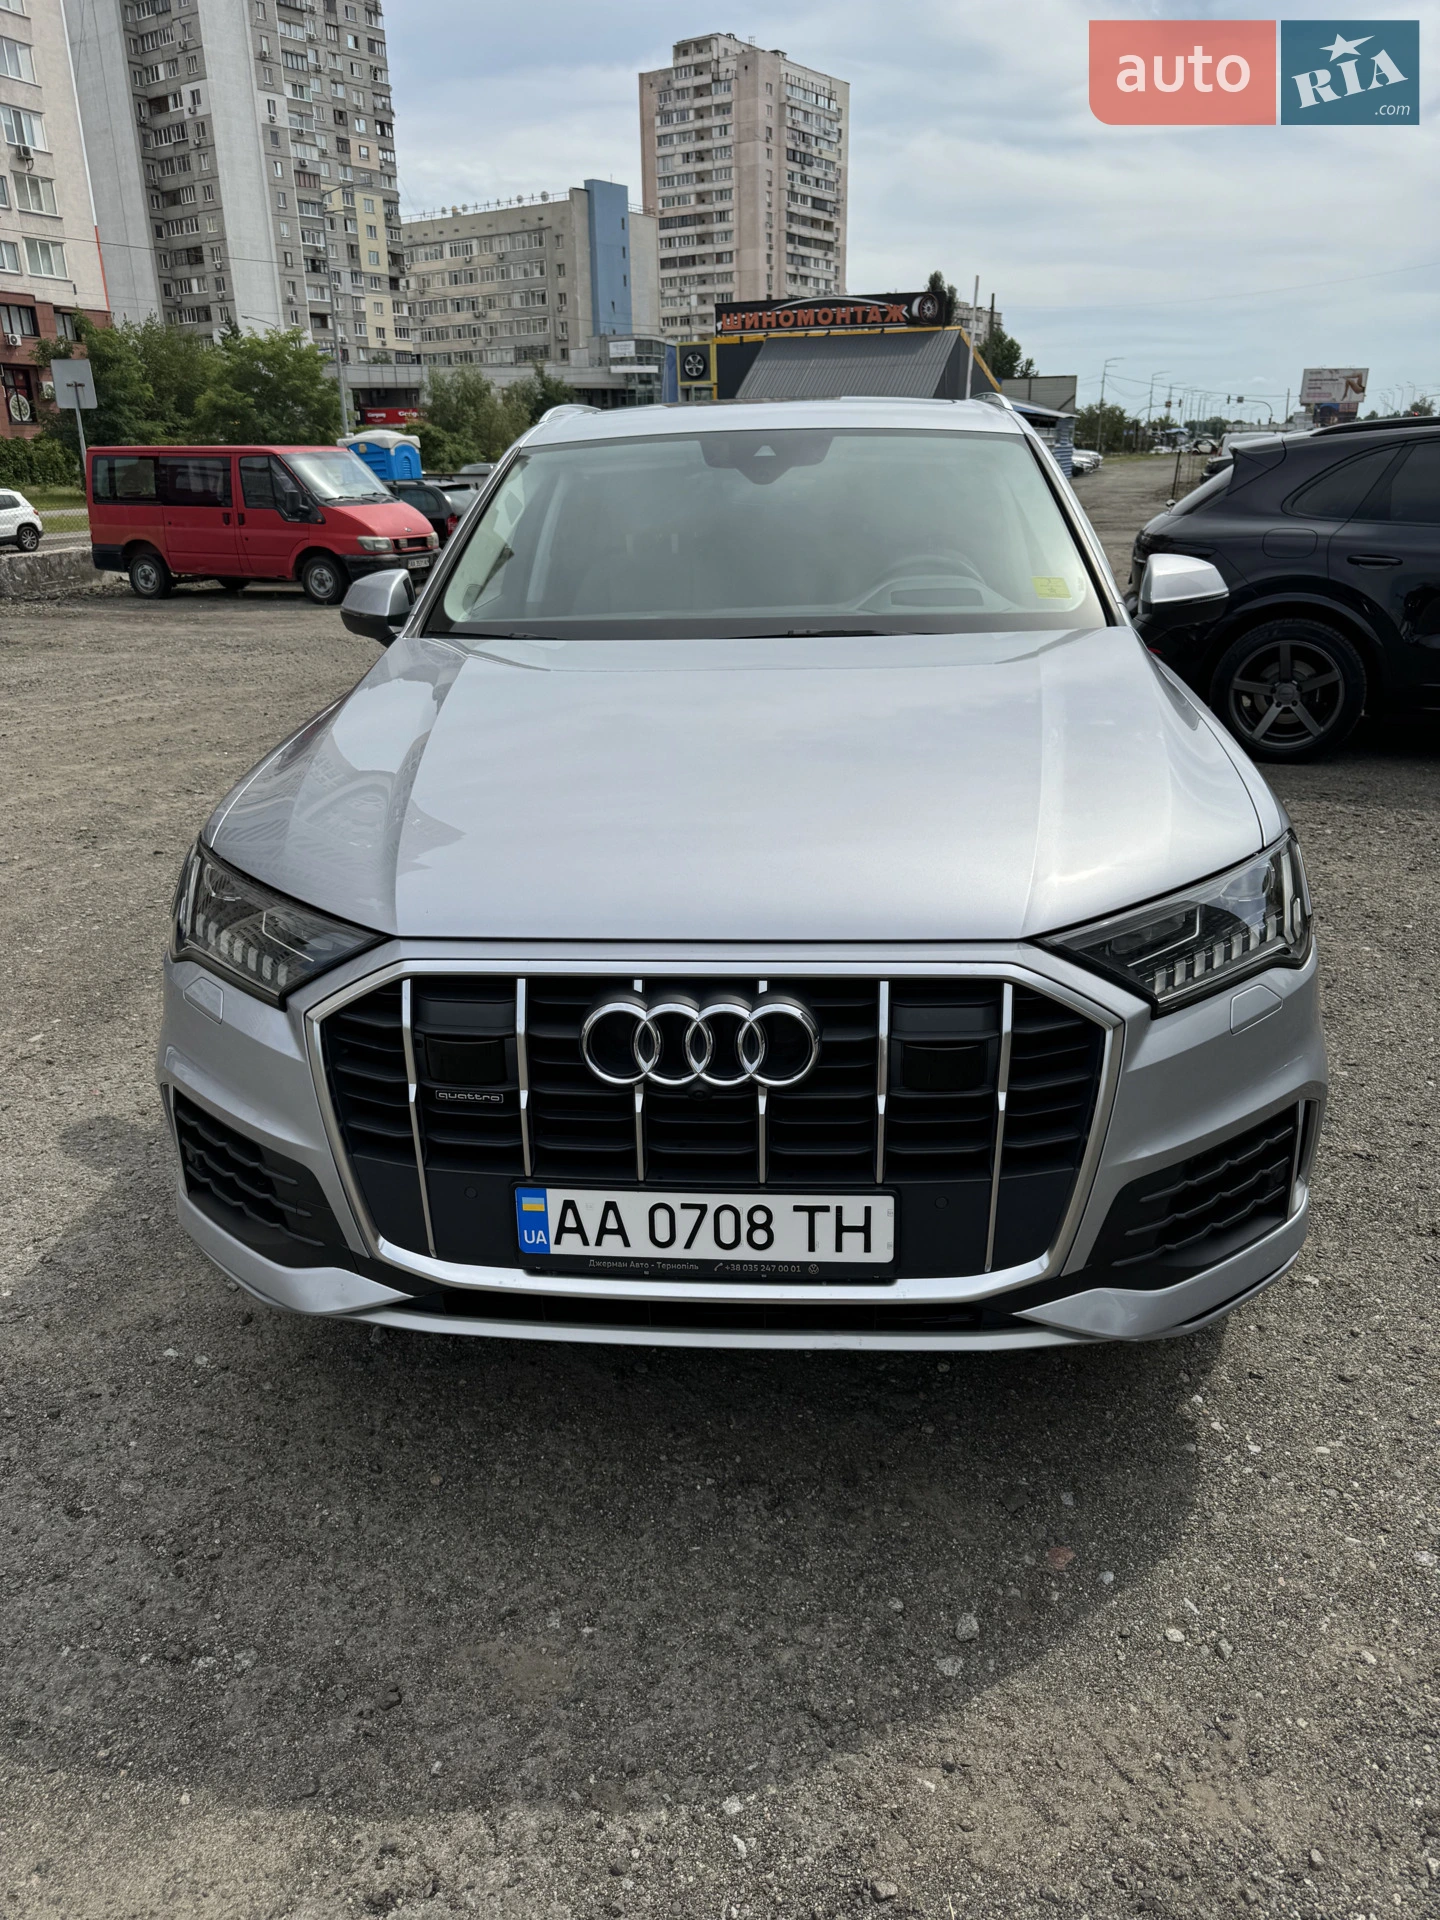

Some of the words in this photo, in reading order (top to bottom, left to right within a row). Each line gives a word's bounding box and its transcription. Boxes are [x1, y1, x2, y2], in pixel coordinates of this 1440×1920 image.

[721, 304, 906, 331] ШИНОМОНТАЖ
[438, 1092, 500, 1101] quattro
[554, 1199, 631, 1248] AA
[648, 1202, 775, 1251] 0708
[793, 1205, 872, 1253] TH
[523, 1230, 548, 1245] UA
[588, 1259, 628, 1269] Джерман
[629, 1260, 650, 1269] Авто
[656, 1261, 699, 1270] Тернопіль
[725, 1263, 741, 1271] +38
[742, 1264, 759, 1272] 035
[760, 1264, 776, 1272] 247
[777, 1265, 789, 1273] 00
[790, 1265, 801, 1273] 01
